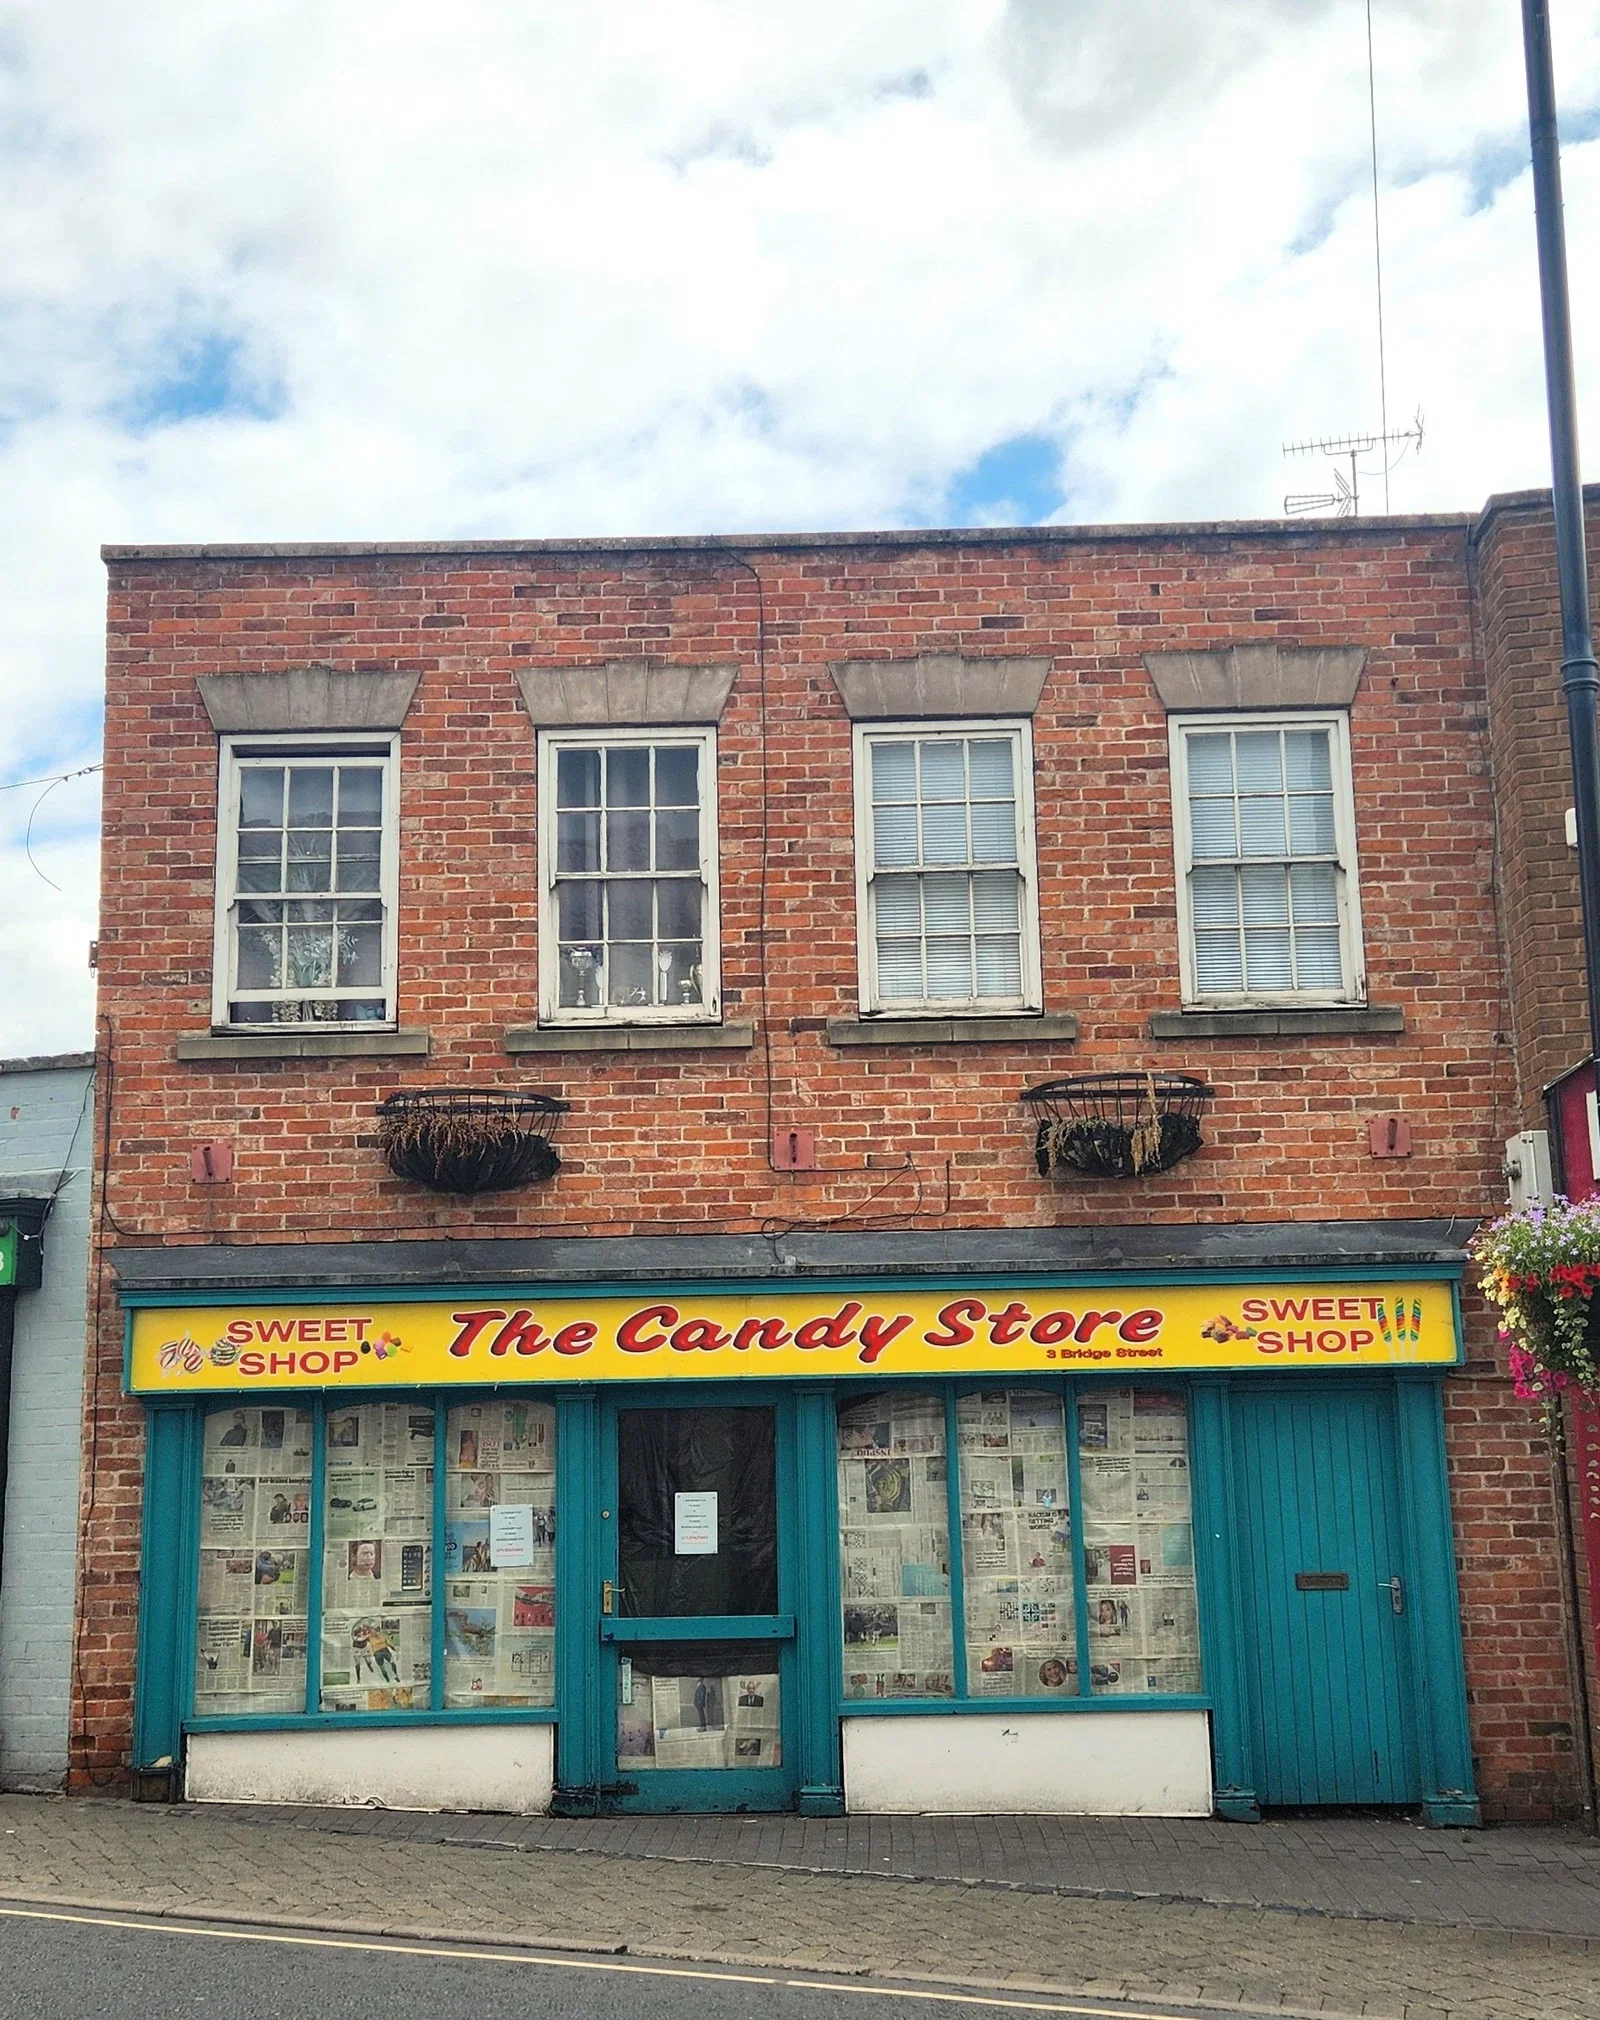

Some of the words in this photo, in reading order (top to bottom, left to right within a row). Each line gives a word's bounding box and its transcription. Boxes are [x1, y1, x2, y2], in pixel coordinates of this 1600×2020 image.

[1242, 1298, 1384, 1322] SWEET
[227, 1318, 372, 1343] SWEET
[450, 1309, 598, 1356] The
[616, 1302, 914, 1363] Candy
[923, 1299, 1163, 1346] Store
[1257, 1330, 1374, 1353] SHOP
[239, 1351, 359, 1375] SHOP
[1046, 1349, 1057, 1358] 3
[1061, 1348, 1111, 1360] Bridge
[1116, 1347, 1163, 1358] Street
